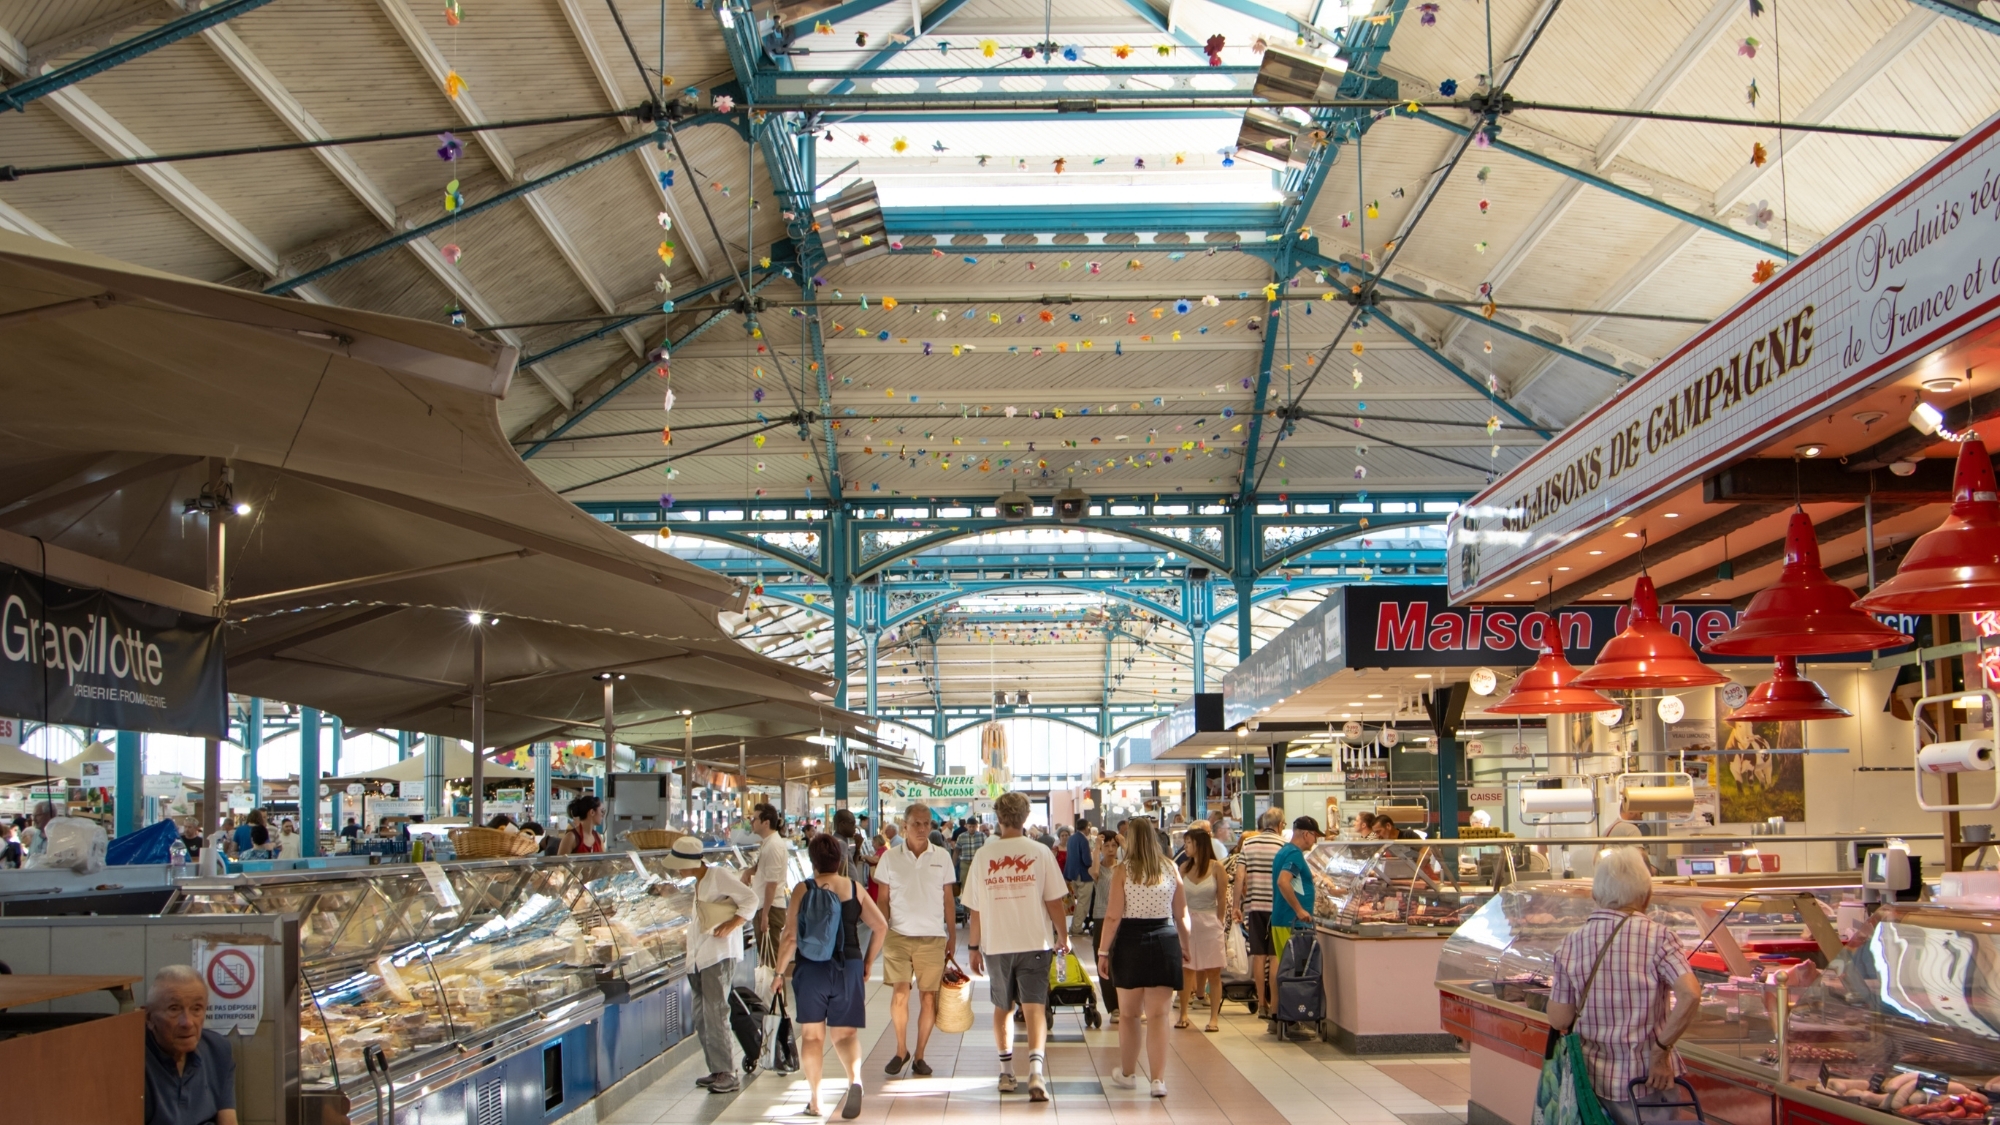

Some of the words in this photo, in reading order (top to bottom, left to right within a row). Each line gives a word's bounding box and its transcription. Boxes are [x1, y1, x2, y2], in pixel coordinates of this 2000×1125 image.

[1856, 199, 1964, 292] Produits
[1843, 325, 1865, 369] de
[1870, 278, 1958, 354] France
[1963, 258, 1986, 300] et
[1609, 420, 1641, 479] DE
[1646, 304, 1815, 455] CAMPAGNE
[2, 594, 163, 687] Grapillotte
[1375, 601, 1592, 651] Maison
[907, 787, 922, 797] La
[928, 787, 974, 797] Rascasse
[1470, 793, 1503, 801] CAISSE
[984, 876, 997, 885] TAG
[227, 1003, 257, 1011] DÉPOSER
